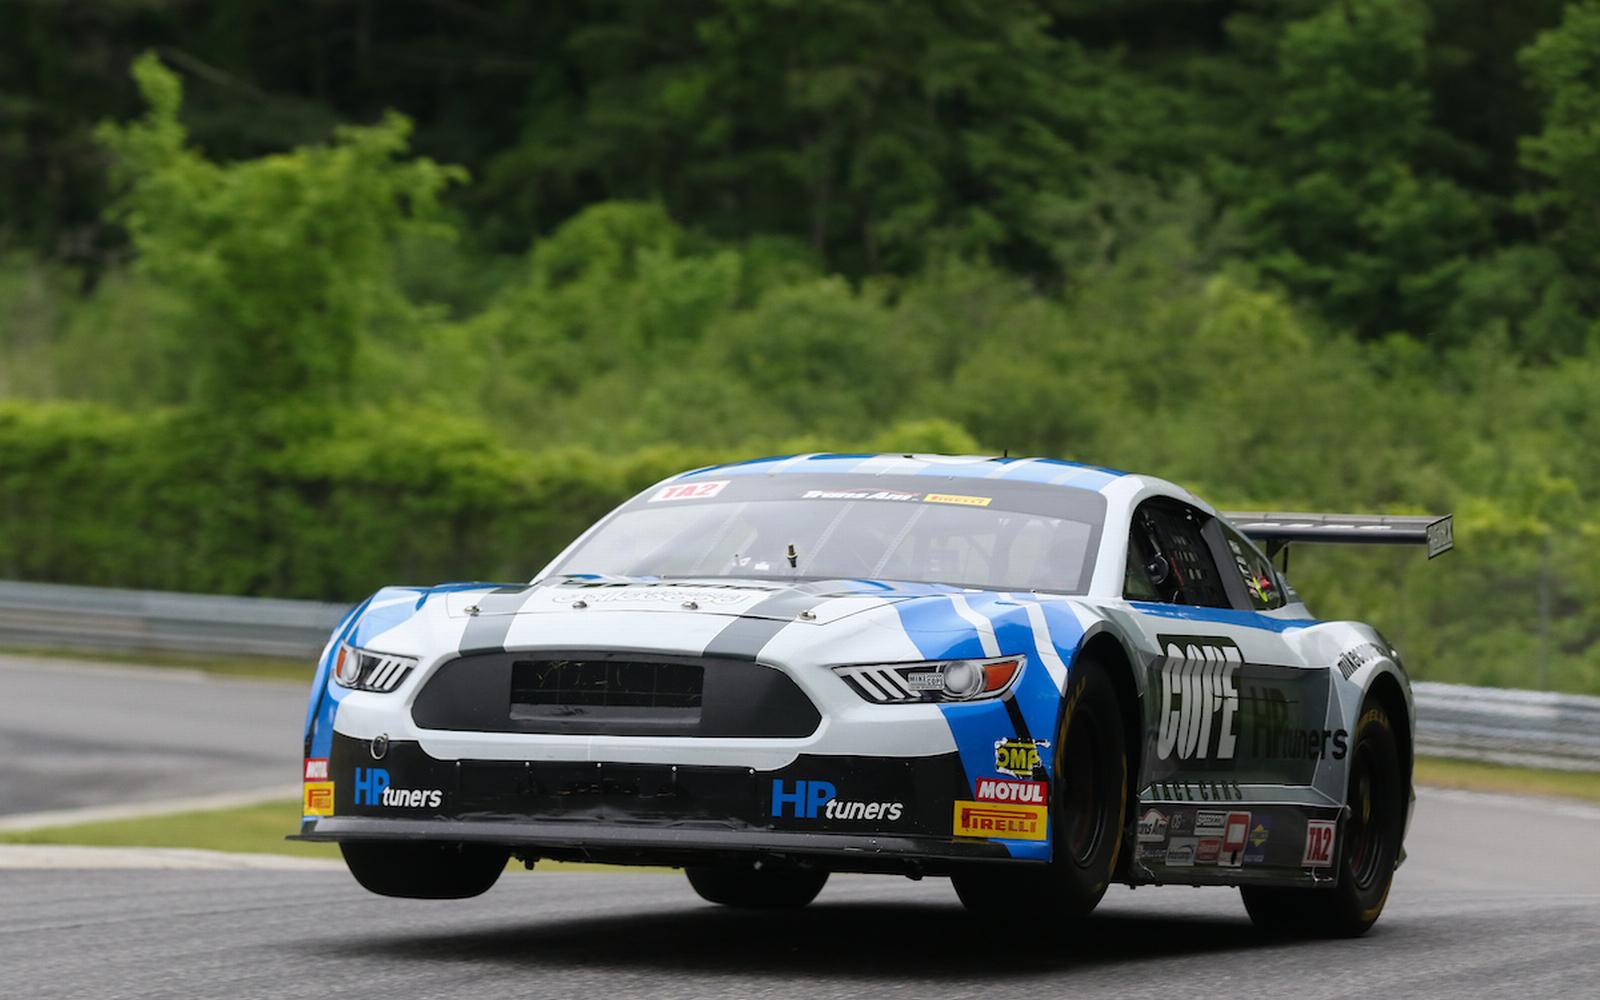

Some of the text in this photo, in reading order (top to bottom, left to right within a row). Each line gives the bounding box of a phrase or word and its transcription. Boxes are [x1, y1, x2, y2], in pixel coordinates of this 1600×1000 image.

[661, 483, 719, 499] TA2
[802, 490, 869, 499] Trans
[1157, 642, 1243, 761] COPE
[997, 747, 1041, 770] OMP
[978, 781, 1043, 803] MOTUL
[961, 808, 1038, 833] PIRELLI
[1306, 827, 1332, 861] TA2
